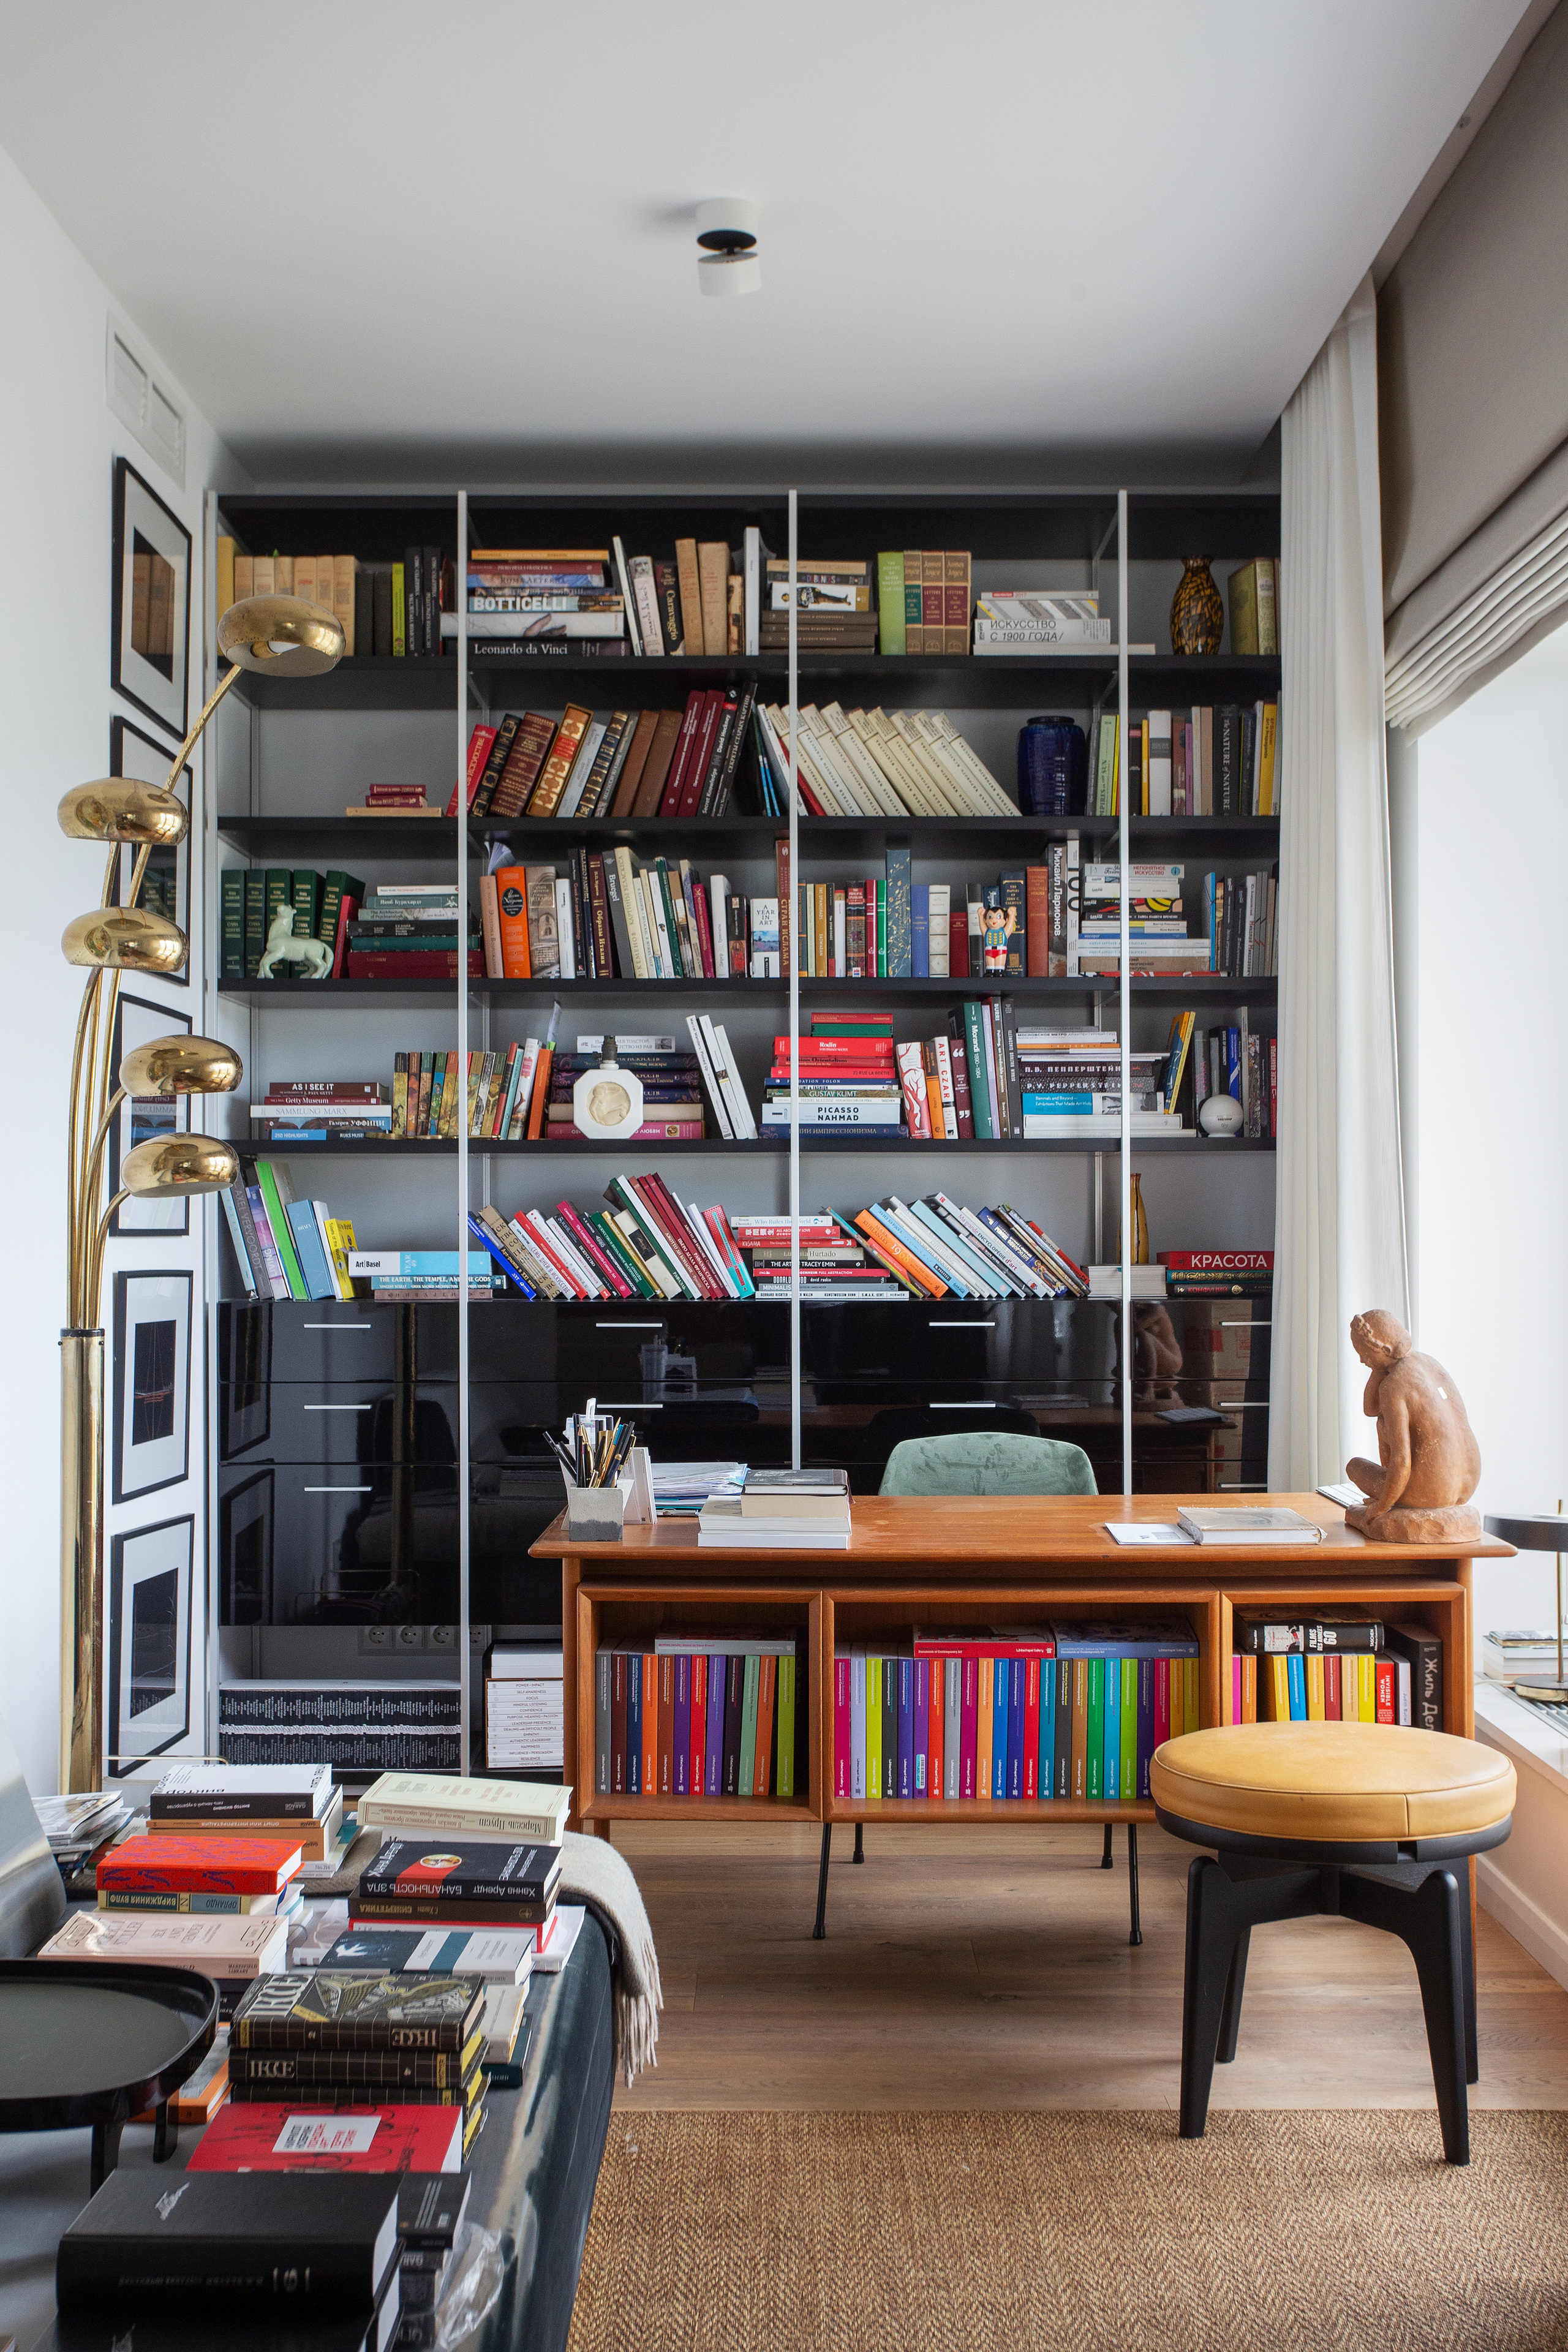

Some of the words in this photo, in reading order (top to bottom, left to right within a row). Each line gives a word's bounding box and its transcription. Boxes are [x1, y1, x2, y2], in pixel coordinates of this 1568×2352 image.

[474, 597, 567, 611] BOTTICELLI
[666, 590, 677, 640] Caravaggio
[990, 620, 1056, 629] ИСКУССТВО
[990, 633, 997, 642] С
[1003, 633, 1025, 642] 1900
[475, 644, 522, 654] Leonardo
[526, 644, 537, 654] da
[541, 644, 567, 654] Vinci
[719, 713, 731, 737] Hockney
[760, 708, 774, 731] Hockney
[715, 736, 725, 753] David
[467, 737, 484, 776] ИСКУССТВЕ
[704, 767, 718, 797] Knowledge
[701, 797, 710, 813] Secret
[1053, 847, 1062, 885] Михаил
[609, 874, 619, 902] Bruegel
[1053, 887, 1062, 936] Ларионов
[688, 1017, 697, 1031] Marcel
[699, 1051, 707, 1066] Pinned
[971, 1025, 979, 1052] Morandi
[938, 1044, 947, 1063] ART
[233, 1188, 246, 1212] AXEL
[579, 1229, 595, 1248] Language
[862, 1219, 889, 1245] KURLANSKY
[874, 1224, 889, 1238] MARK
[239, 1213, 262, 1270] VERVOORDT
[957, 1213, 967, 1223] Ma
[964, 1219, 979, 1235] grande
[976, 1231, 1007, 1261] ENCYCLOPÉDIE
[1004, 1257, 1019, 1272] d'art
[578, 1245, 597, 1267] ИСКУССТВО
[889, 1242, 912, 1264] 1968
[1191, 1255, 1267, 1267] КРАСОТА
[263, 1248, 277, 1278] LIVING
[500, 1247, 519, 1269] Арт-рынок
[521, 1271, 530, 1281] XXI
[527, 1279, 537, 1290] веке
[530, 1246, 542, 1259] СЕМЬ
[539, 1256, 550, 1268] ДНЕЙ
[550, 1270, 570, 1294] ИСКУССТВЕ
[677, 1237, 688, 1252] ПЬЕРО
[685, 1250, 696, 1265] ДЕЛЛА
[693, 1264, 711, 1289] ФРАНЧЕСКА
[671, 1271, 687, 1290] РАФАЭЛЬ
[937, 1267, 950, 1280] PRESTEL
[566, 1275, 580, 1292] ИСКУССТВА
[952, 1282, 965, 1294] GARAGE
[964, 1283, 976, 1295] TASCHEN
[1323, 1630, 1337, 1645] 60
[1425, 1658, 1438, 1698] Жиль
[1423, 1702, 1438, 1731] Дел
[478, 1817, 505, 1830] Пруст
[507, 1820, 541, 1834] Марсель
[366, 1881, 386, 1892] ЗЛА
[389, 1882, 462, 1894] БАНАЛЬНОСТЬ
[472, 1884, 505, 1896] Арендт
[507, 1886, 535, 1897] Ханна
[109, 1894, 128, 1904] ВУЛФ
[130, 1894, 176, 1905] ВИРДЖИНИЯ
[206, 1899, 237, 1909] ОРЛАНДО
